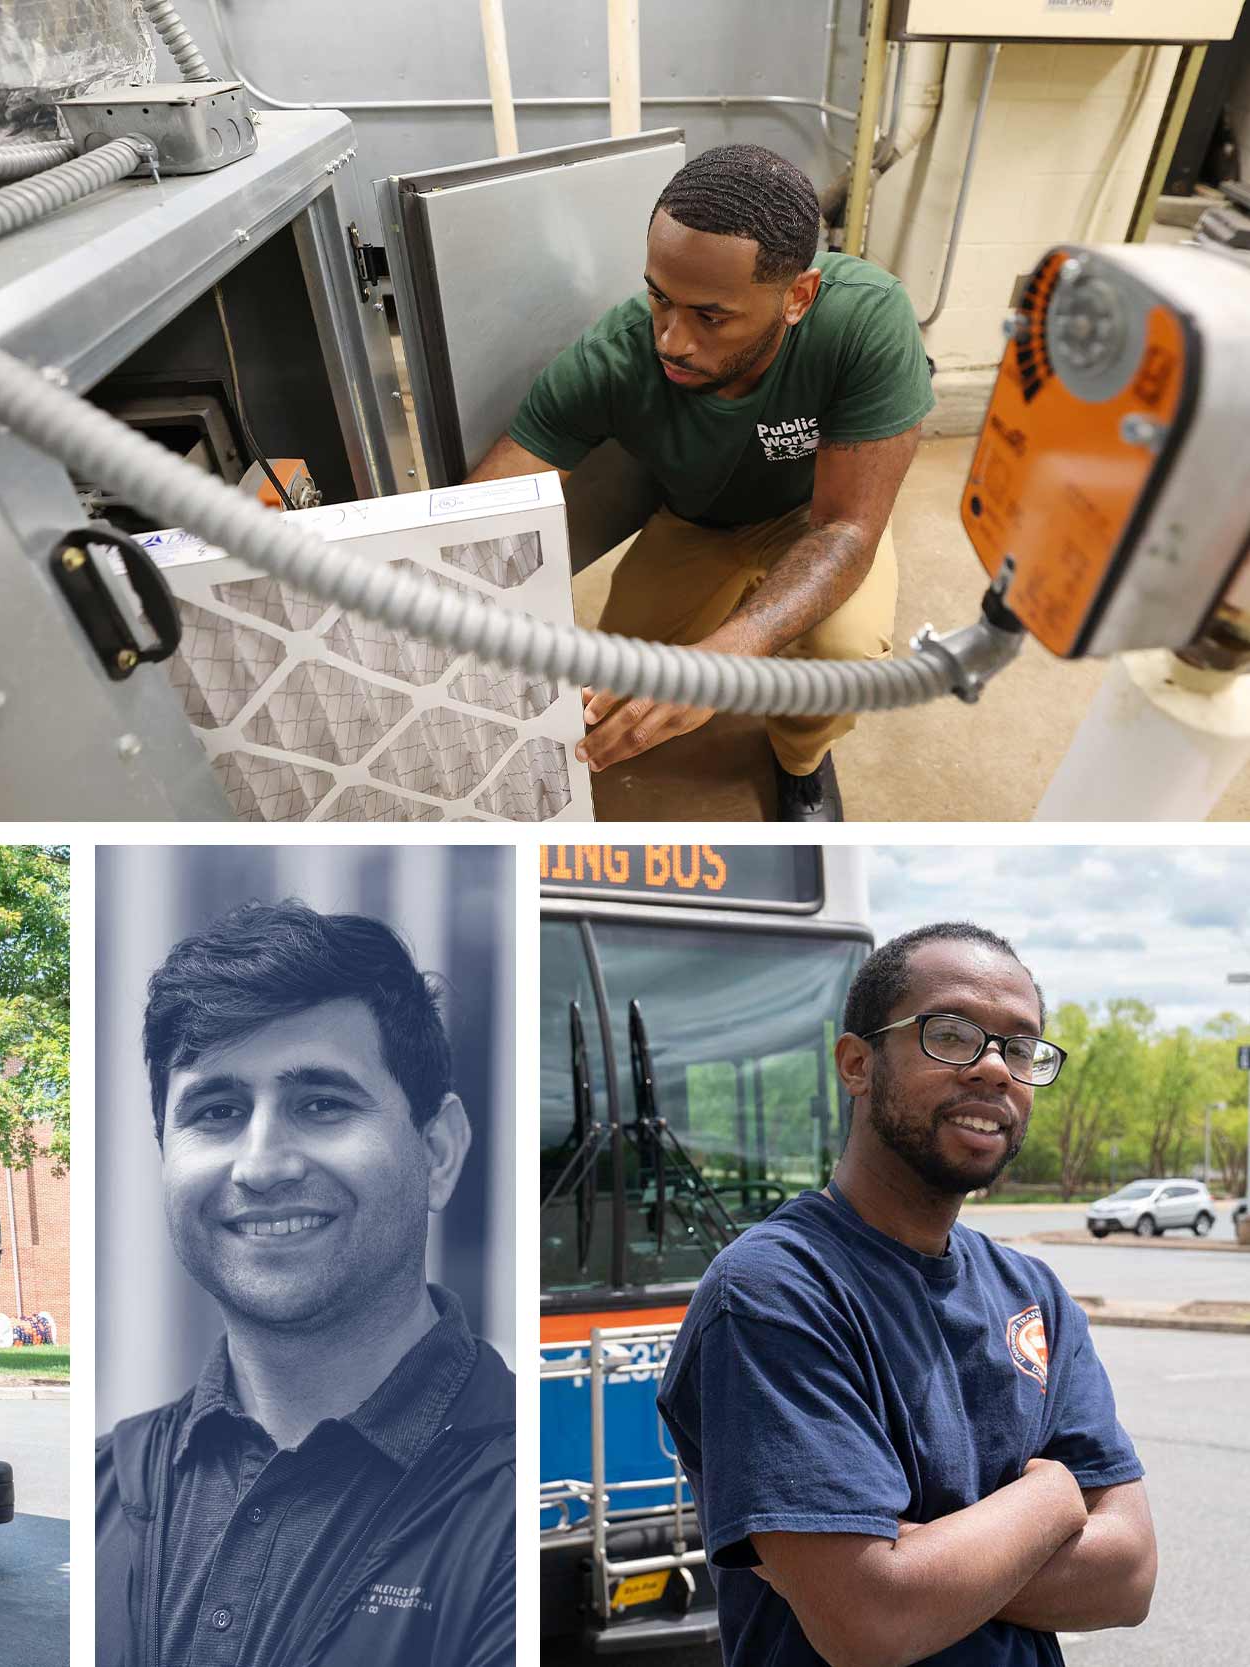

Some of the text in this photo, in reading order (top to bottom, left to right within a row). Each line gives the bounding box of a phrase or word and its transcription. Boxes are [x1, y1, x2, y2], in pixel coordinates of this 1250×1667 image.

[756, 417, 819, 438] Public
[760, 429, 820, 448] Works
[645, 845, 727, 890] BUS
